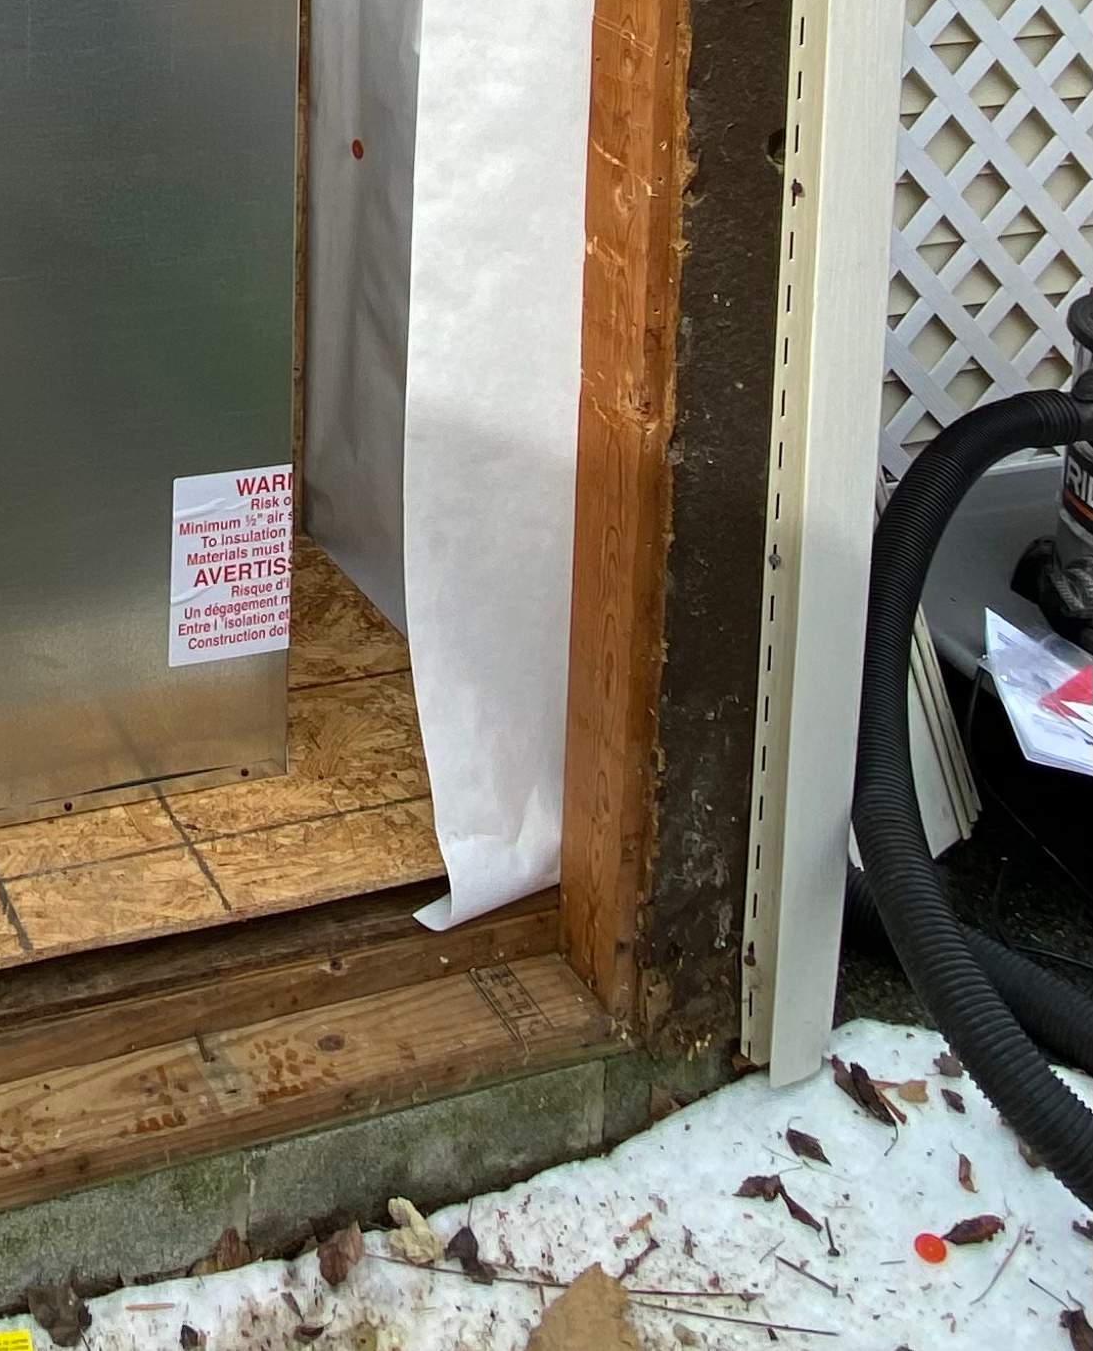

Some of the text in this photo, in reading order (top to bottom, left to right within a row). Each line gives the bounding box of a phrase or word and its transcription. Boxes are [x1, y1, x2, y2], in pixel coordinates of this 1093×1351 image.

[251, 497, 279, 511] Risk
[179, 518, 241, 536] Minimum
[267, 512, 284, 524] air
[187, 547, 248, 566] Materials
[252, 541, 285, 557] must
[201, 536, 217, 549] To
[231, 580, 273, 599] Risque
[184, 606, 201, 620] Un
[205, 596, 278, 618] dégagement
[178, 620, 211, 637] Entre
[278, 610, 290, 622] et
[188, 623, 290, 650] Construction doi
